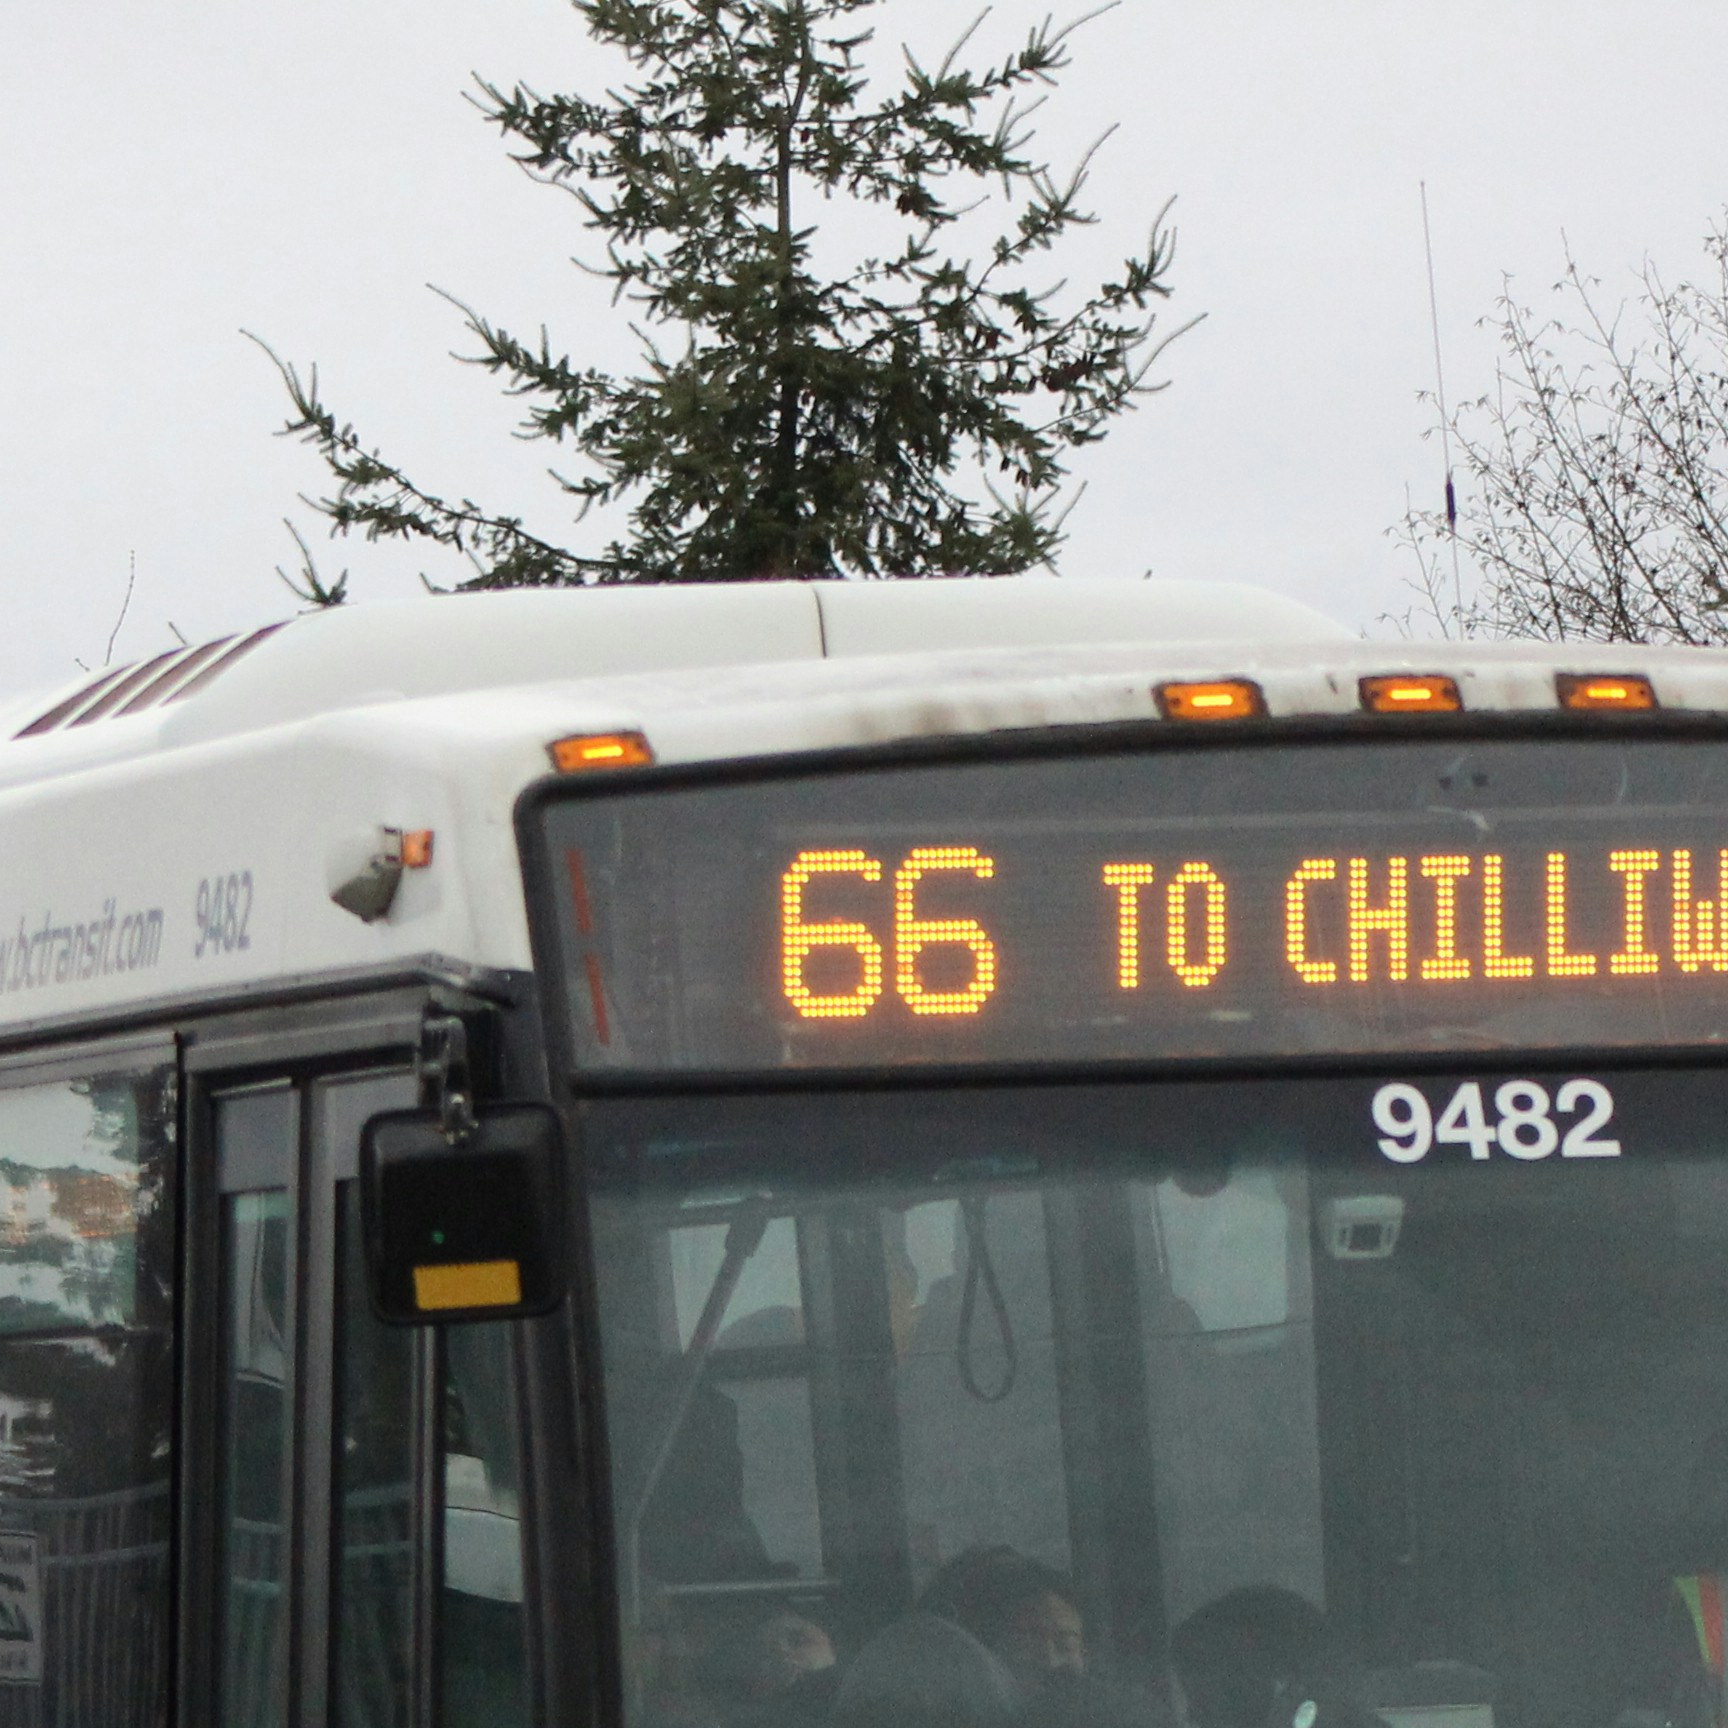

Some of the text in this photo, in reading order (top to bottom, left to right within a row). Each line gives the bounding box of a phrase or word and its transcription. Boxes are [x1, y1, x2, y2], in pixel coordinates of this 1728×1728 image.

[195, 870, 253, 959] 9482
[782, 846, 995, 1019] 66
[1102, 860, 1227, 988] TO
[1371, 1078, 1622, 1164] 9482
